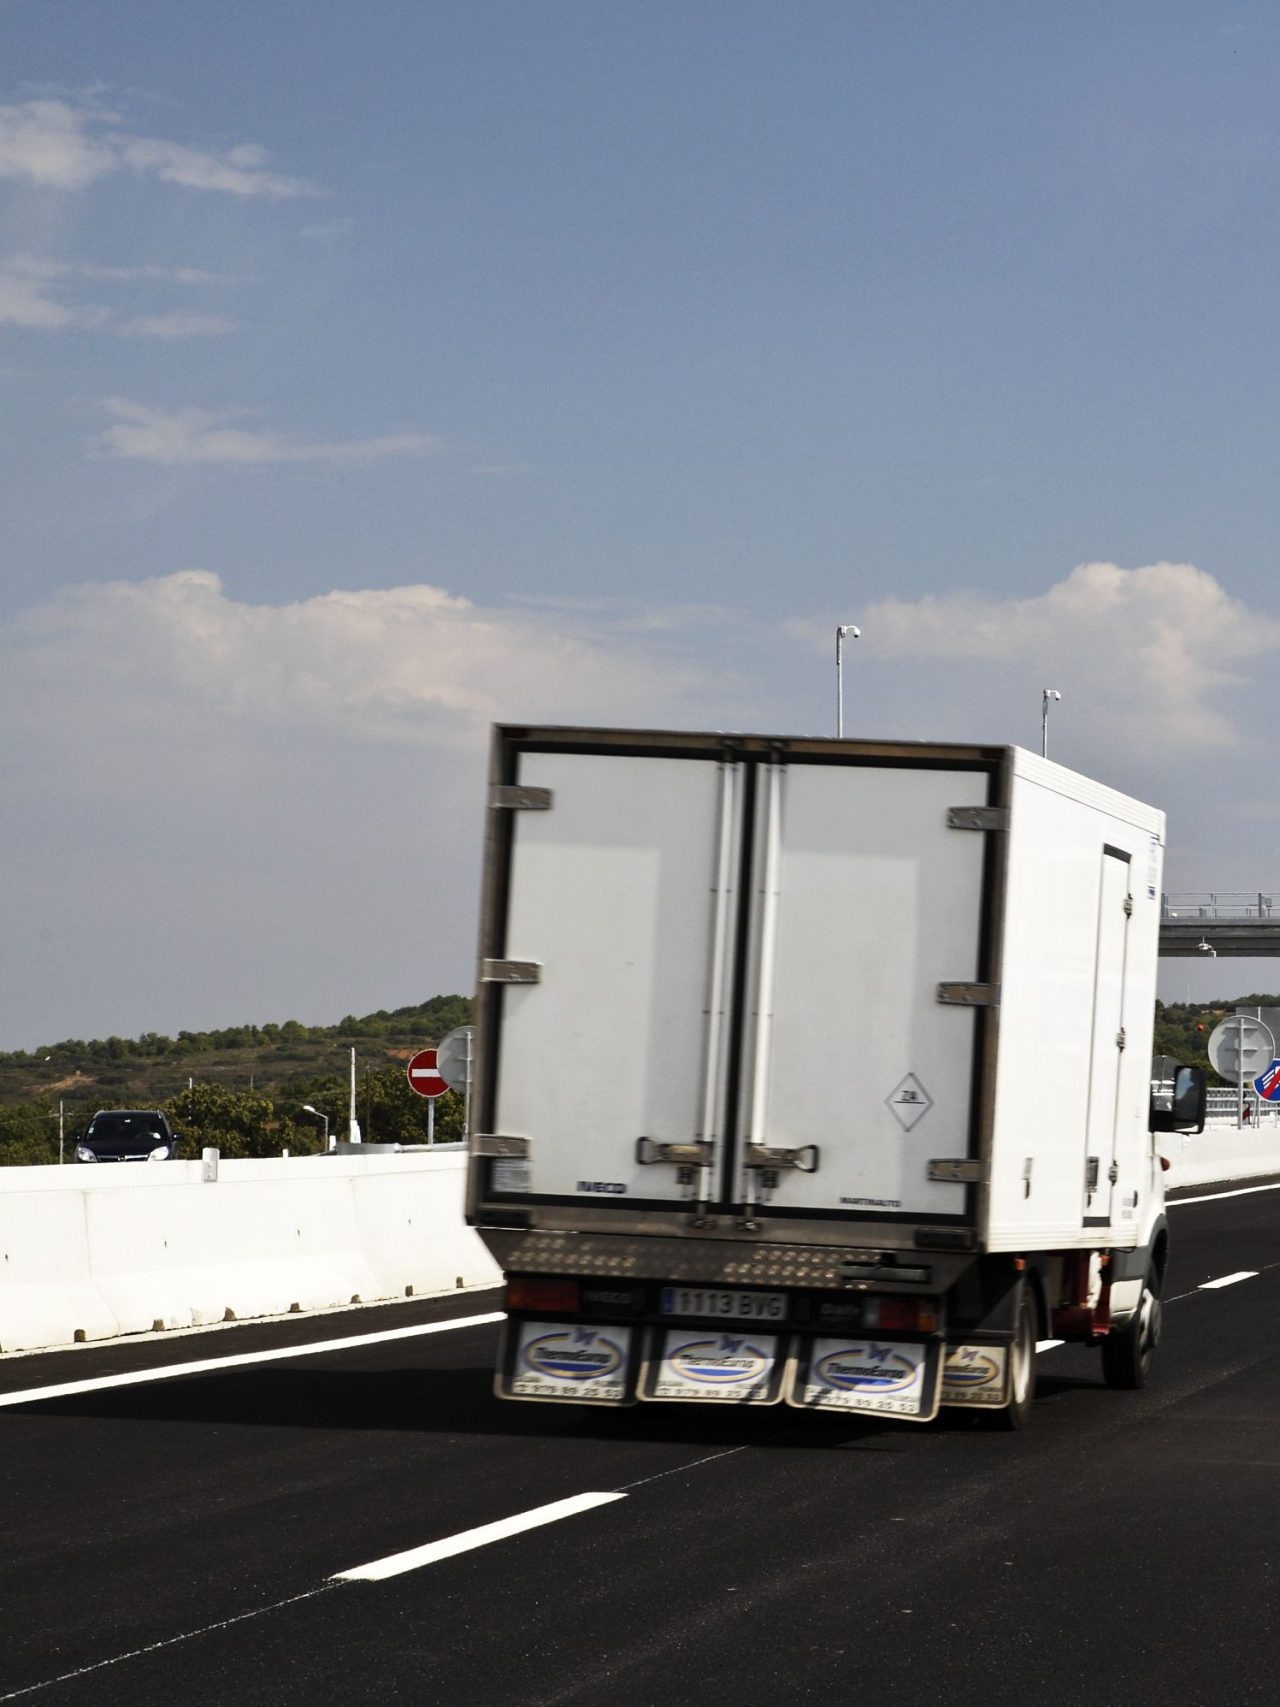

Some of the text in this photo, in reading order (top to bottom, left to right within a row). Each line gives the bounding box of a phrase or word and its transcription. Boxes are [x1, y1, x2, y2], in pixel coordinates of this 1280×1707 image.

[577, 1181, 627, 1194] IVECO
[680, 1291, 783, 1318] 1113 BVG
